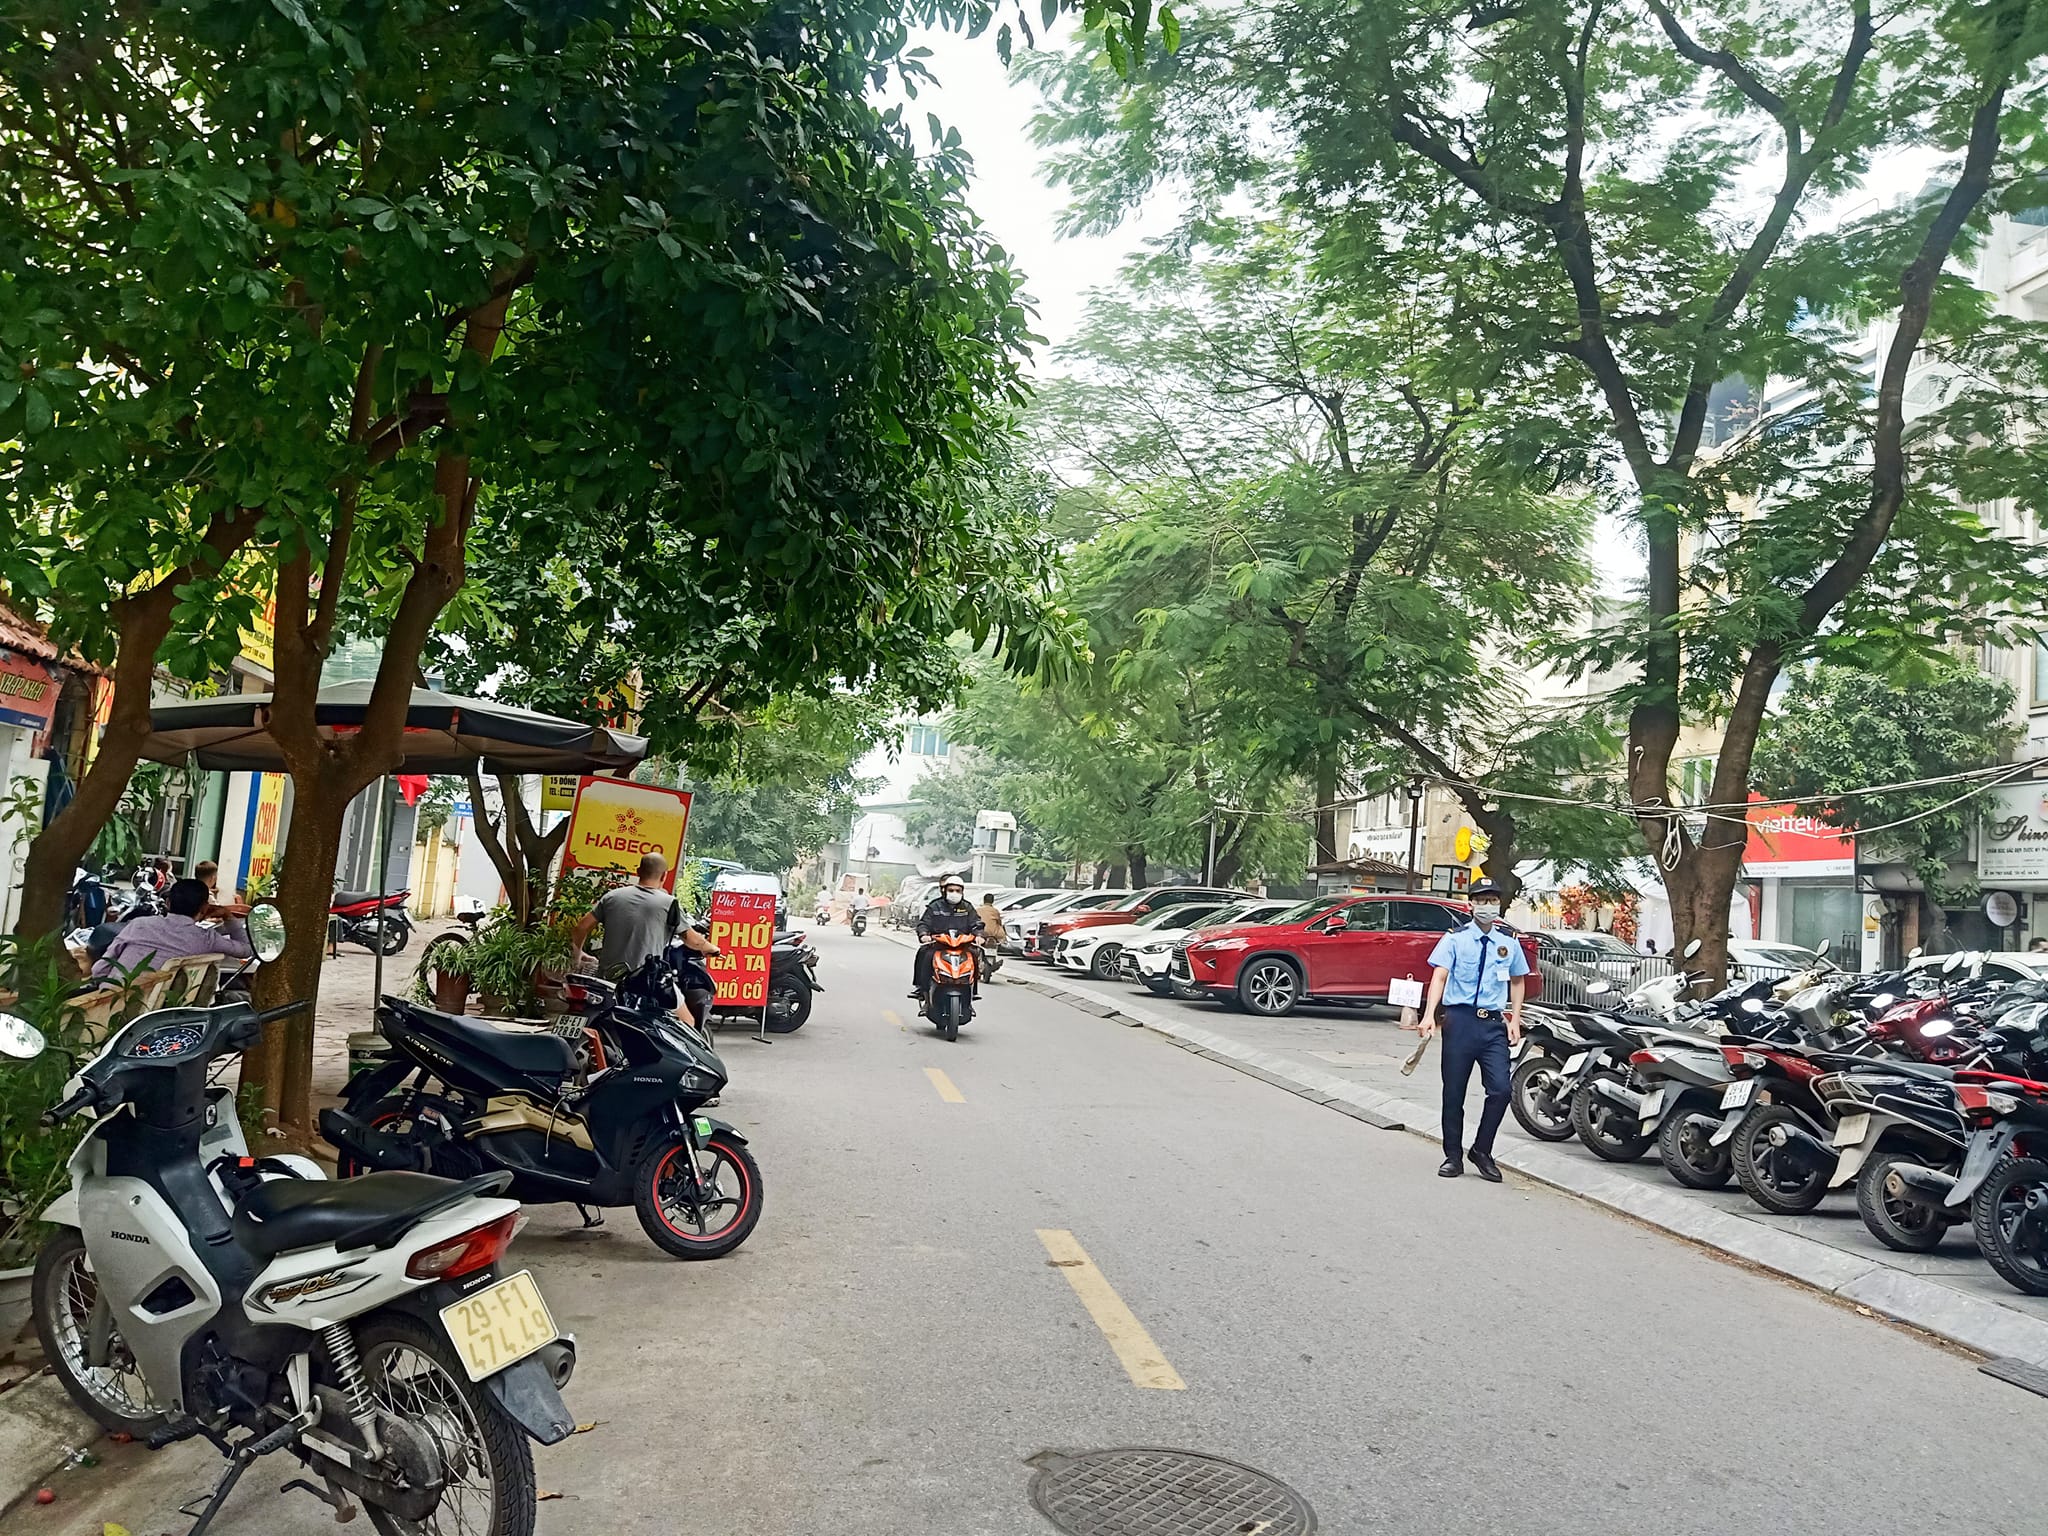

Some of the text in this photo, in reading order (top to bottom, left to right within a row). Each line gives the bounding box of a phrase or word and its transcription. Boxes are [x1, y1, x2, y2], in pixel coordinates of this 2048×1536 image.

[584, 831, 664, 857] HABECO
[711, 915, 772, 949] PHỞ
[709, 950, 766, 972] GÀ TA
[716, 976, 764, 1000] HỐ CỔ
[633, 1076, 663, 1084] HONDA
[110, 1230, 151, 1245] HONDA
[462, 1273, 493, 1290] HONDA
[457, 1281, 529, 1337] 29-F1
[468, 1309, 551, 1370] 474.49
